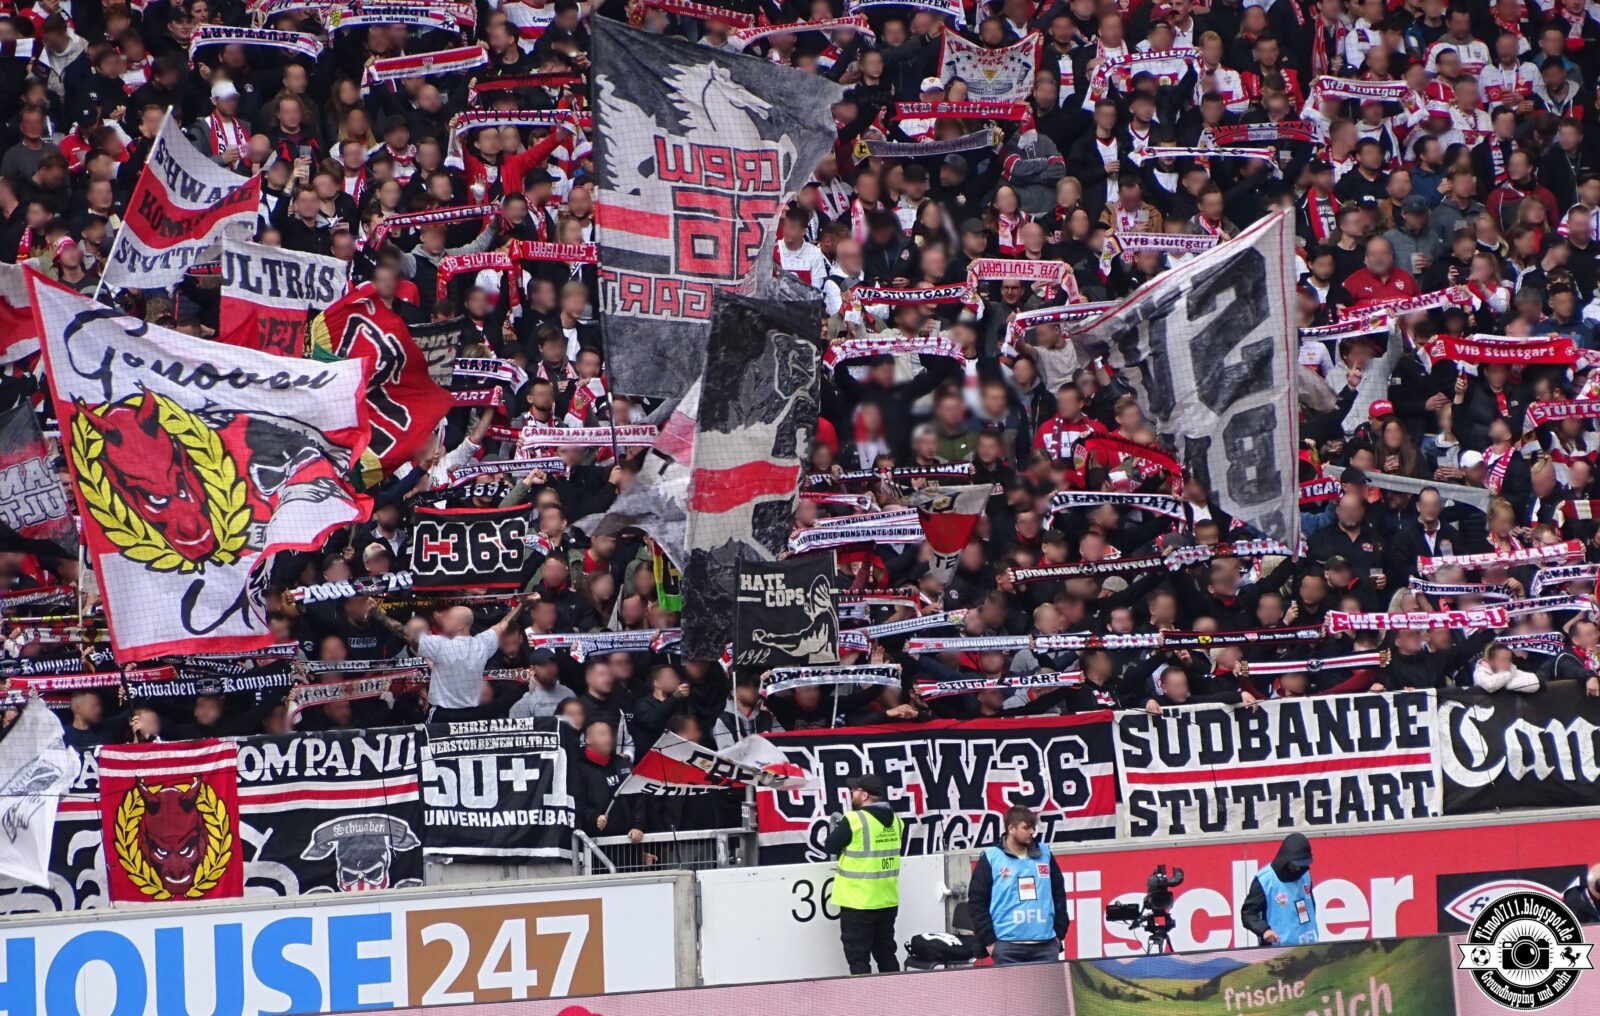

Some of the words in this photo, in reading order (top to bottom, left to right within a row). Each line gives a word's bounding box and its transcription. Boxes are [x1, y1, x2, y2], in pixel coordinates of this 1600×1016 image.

[1130, 47, 1203, 62] Stuttgar
[1122, 237, 1149, 247] VfB
[1152, 236, 1214, 250] Stuttgart
[884, 286, 962, 300] STUTTGART
[1454, 344, 1479, 357] VfB
[1484, 342, 1556, 360] Stuttgart
[809, 531, 839, 543] EINZIGE
[840, 527, 887, 538] KONSTANTE
[889, 527, 908, 537] SIND
[1097, 557, 1162, 574] STUTTGAR
[740, 573, 786, 591] HATE
[297, 581, 356, 604] 2006
[765, 589, 805, 607] COPS
[736, 648, 771, 665] 1312
[126, 680, 198, 699] Schwaben
[449, 720, 490, 735] EHRE
[490, 716, 535, 732] ALLEN
[1118, 691, 1431, 769] SÜDBANDE
[429, 735, 514, 756] VERSTORBENEN
[515, 735, 558, 749] ULTRAS
[420, 747, 577, 811] 50+1
[424, 808, 576, 829] UNVERHANDELBAR
[332, 820, 386, 837] Schwaben
[1012, 907, 1047, 926] DFL
[419, 913, 592, 1007] 247
[1223, 978, 1306, 1011] frische
